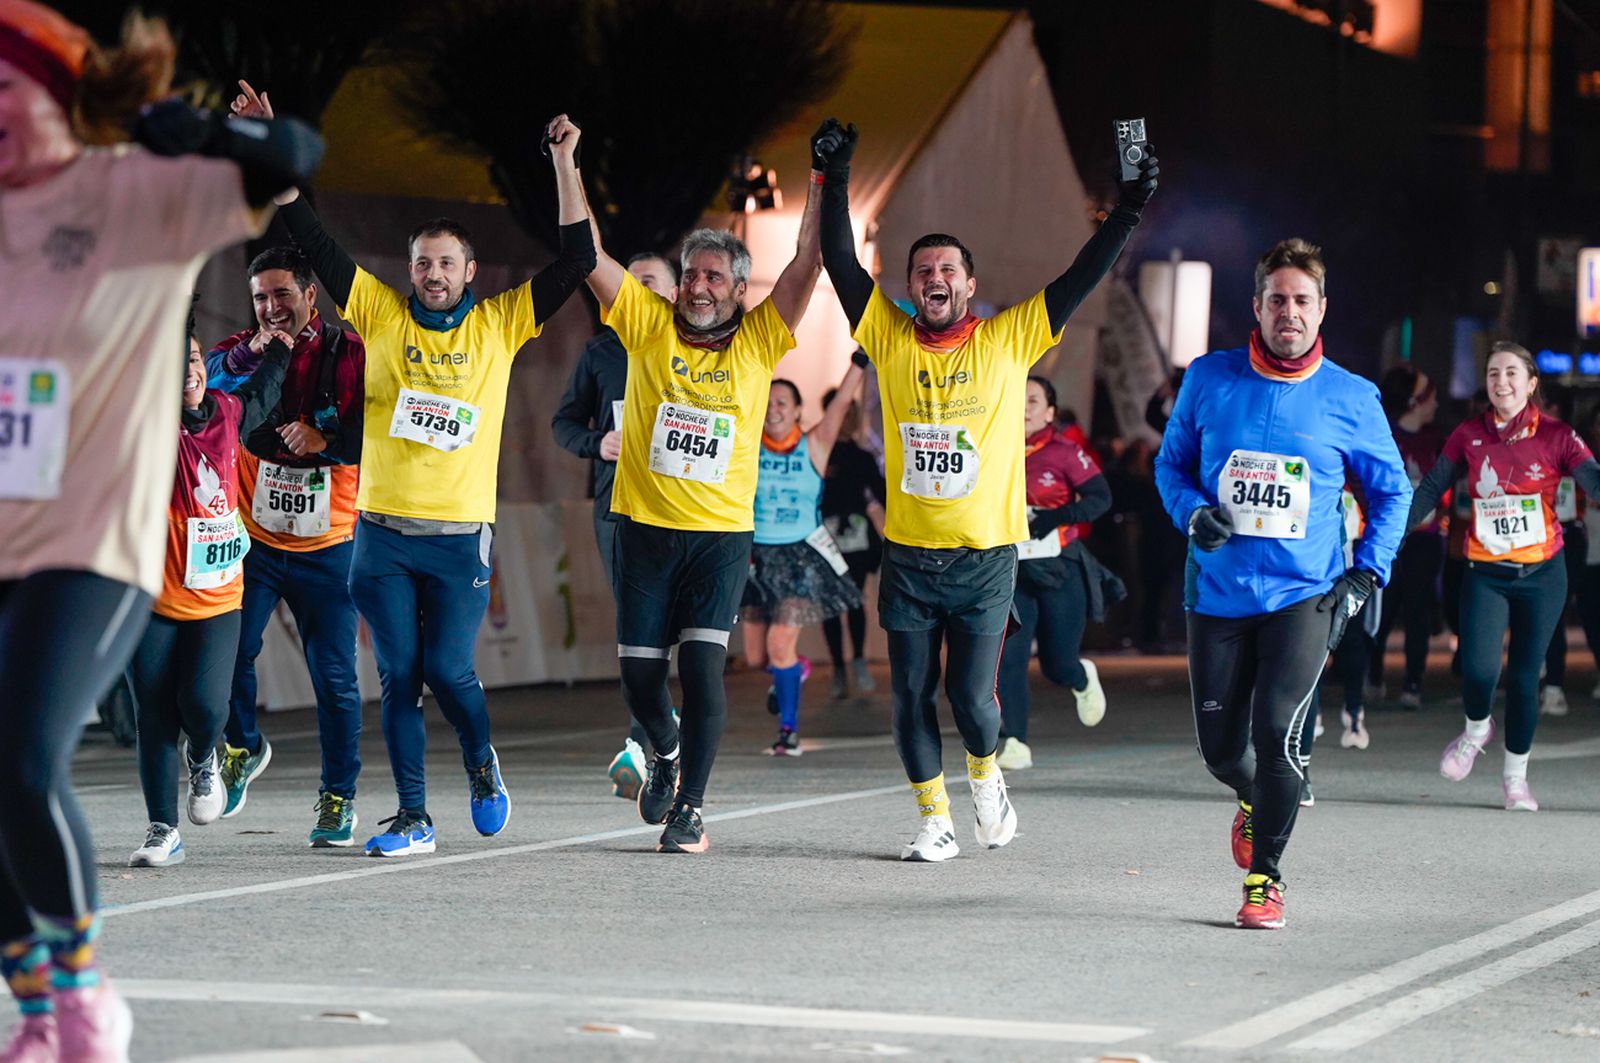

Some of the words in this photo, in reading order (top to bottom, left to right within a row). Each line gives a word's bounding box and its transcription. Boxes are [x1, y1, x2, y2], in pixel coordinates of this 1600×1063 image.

[689, 369, 730, 383] unei
[416, 399, 440, 407] NOCHE
[410, 411, 460, 437] 5739
[663, 419, 680, 429] SAN
[674, 413, 697, 424] NOCHE
[698, 416, 708, 425] DE
[916, 432, 939, 440] NOCHE
[666, 429, 719, 459] 6454
[909, 439, 922, 448] SAN
[915, 450, 963, 474] 5739
[1240, 460, 1264, 469] NOCHE
[1266, 462, 1277, 471] DE
[1229, 468, 1244, 478] SAN
[264, 479, 278, 488] SAN
[1232, 480, 1291, 509] 3445
[208, 495, 226, 515] 43
[269, 489, 316, 514] 5691
[1493, 515, 1529, 535] 1921
[197, 533, 213, 543] SAN
[206, 537, 242, 565] 8116
